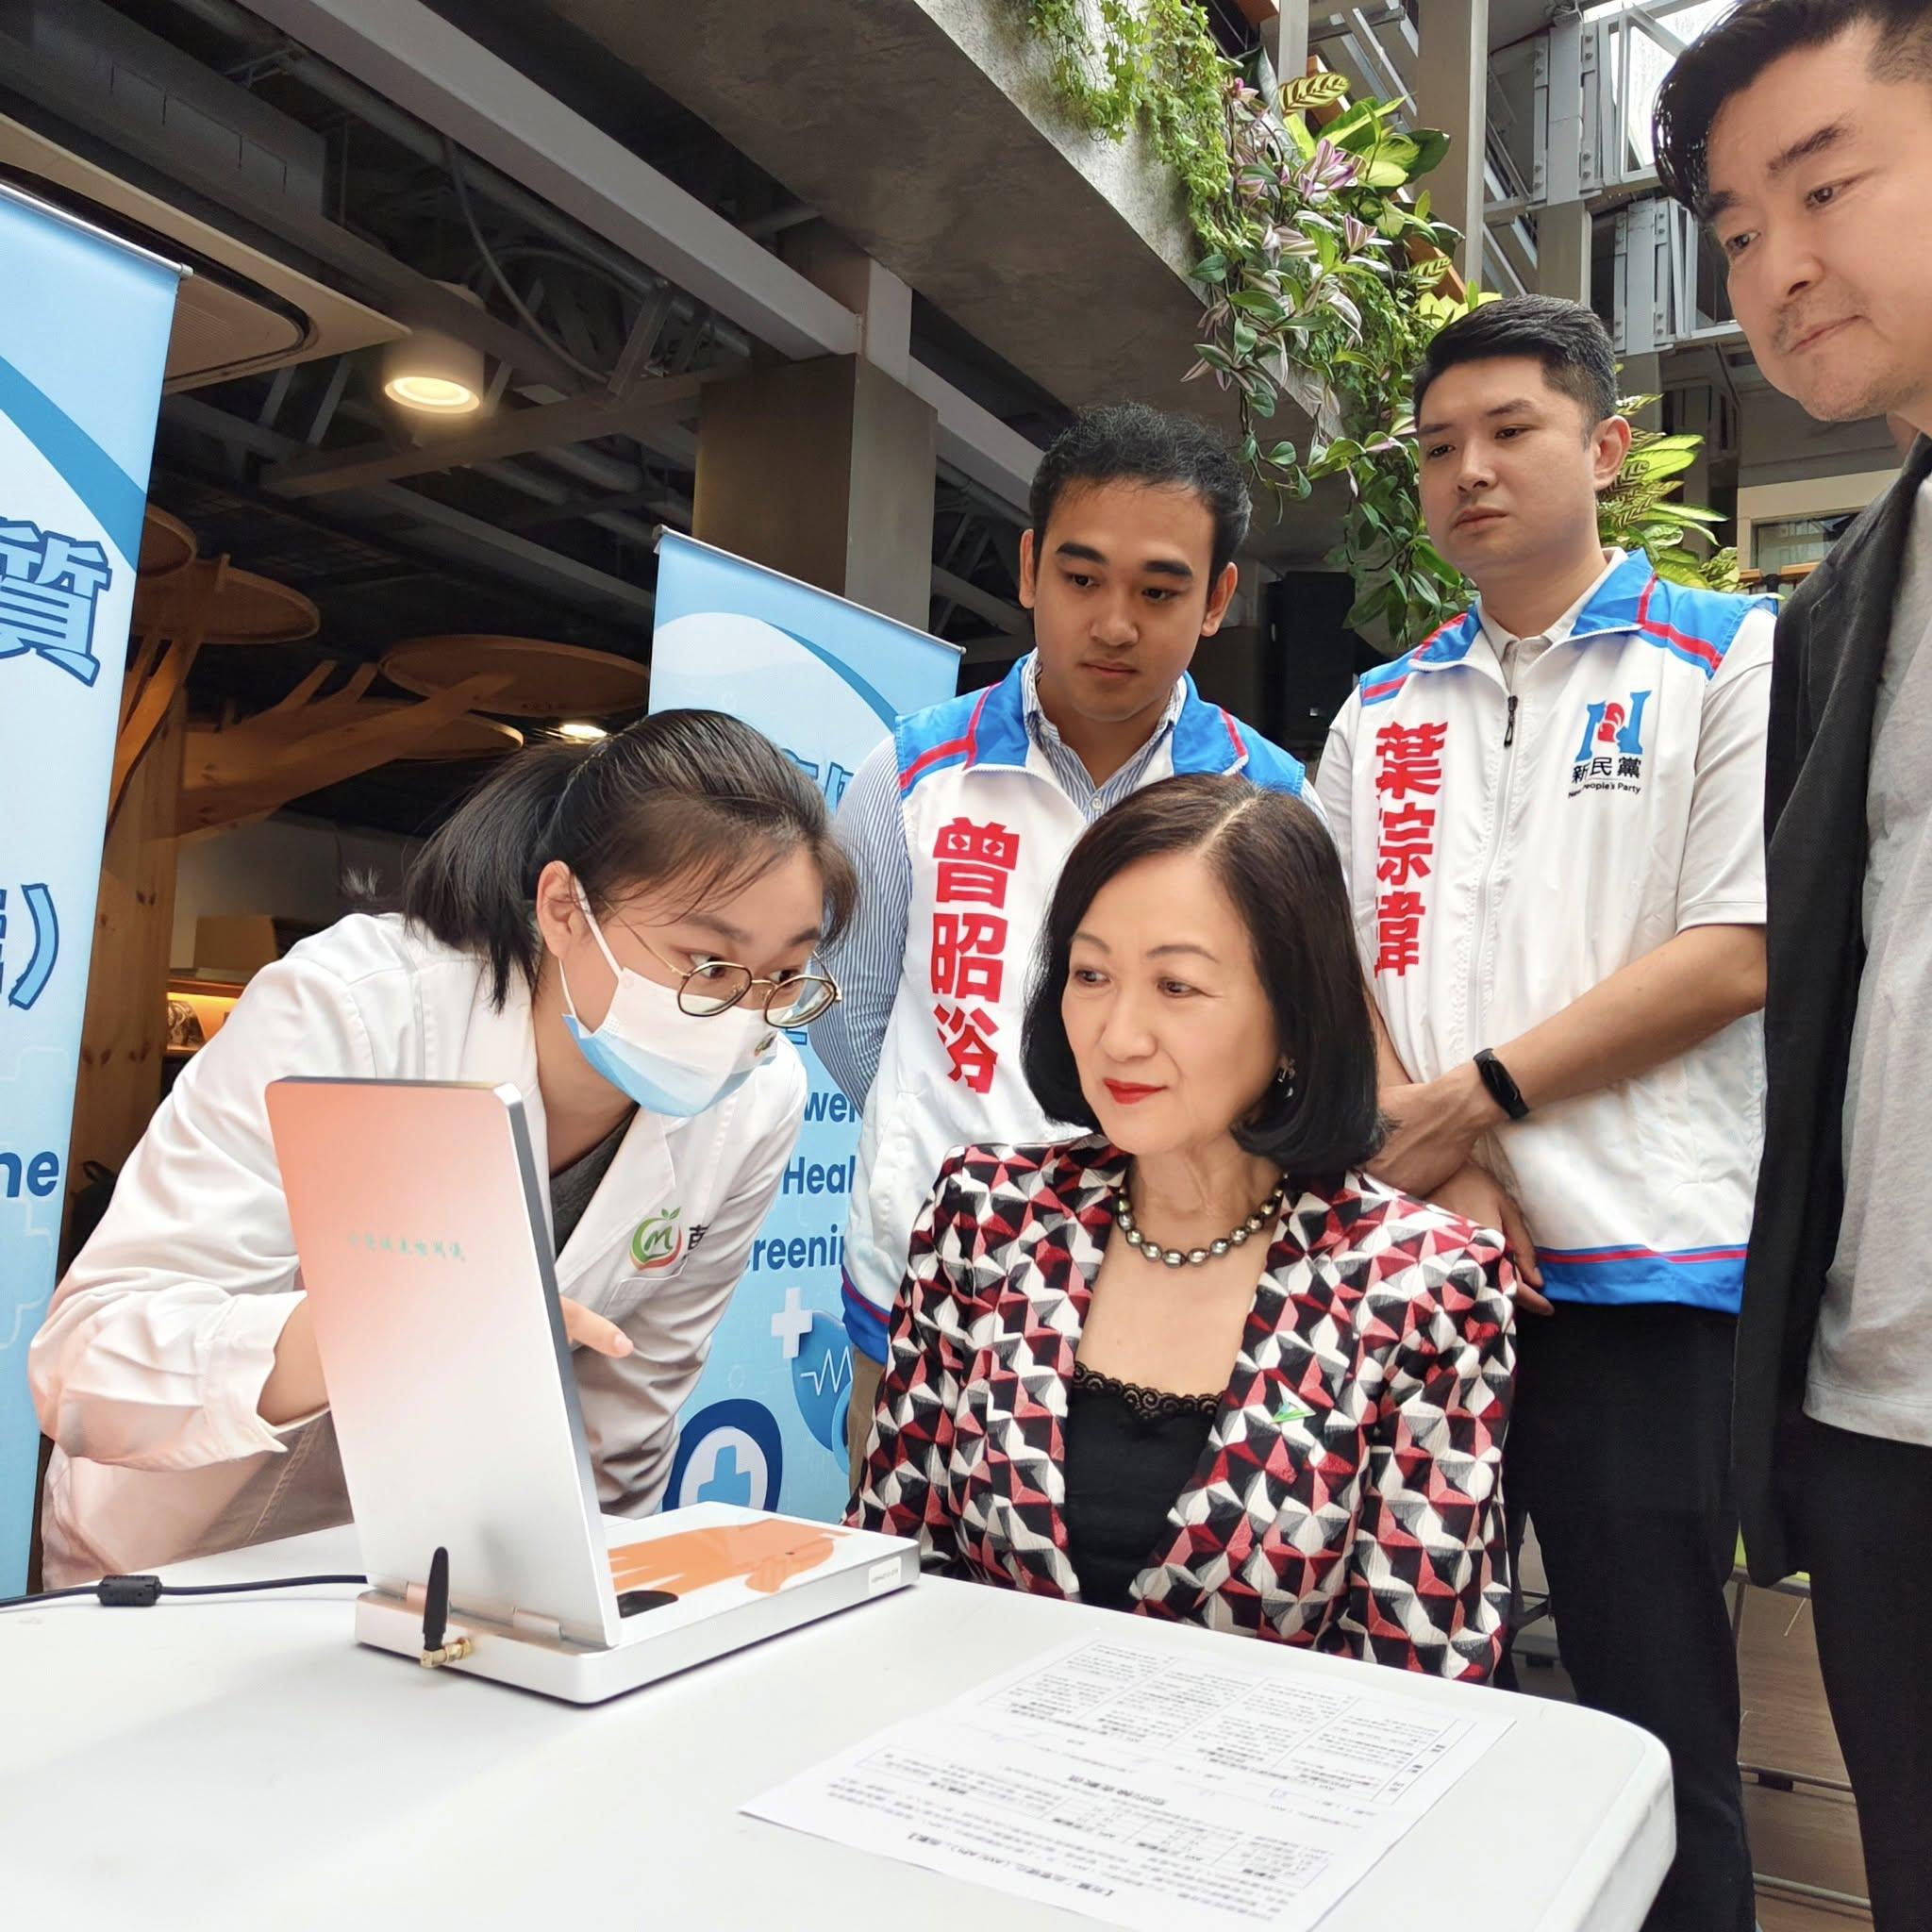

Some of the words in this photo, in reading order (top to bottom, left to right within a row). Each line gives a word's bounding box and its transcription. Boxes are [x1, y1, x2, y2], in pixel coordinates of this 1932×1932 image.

[1572, 757, 1641, 784] 新民黨
[1617, 782, 1641, 794] Party
